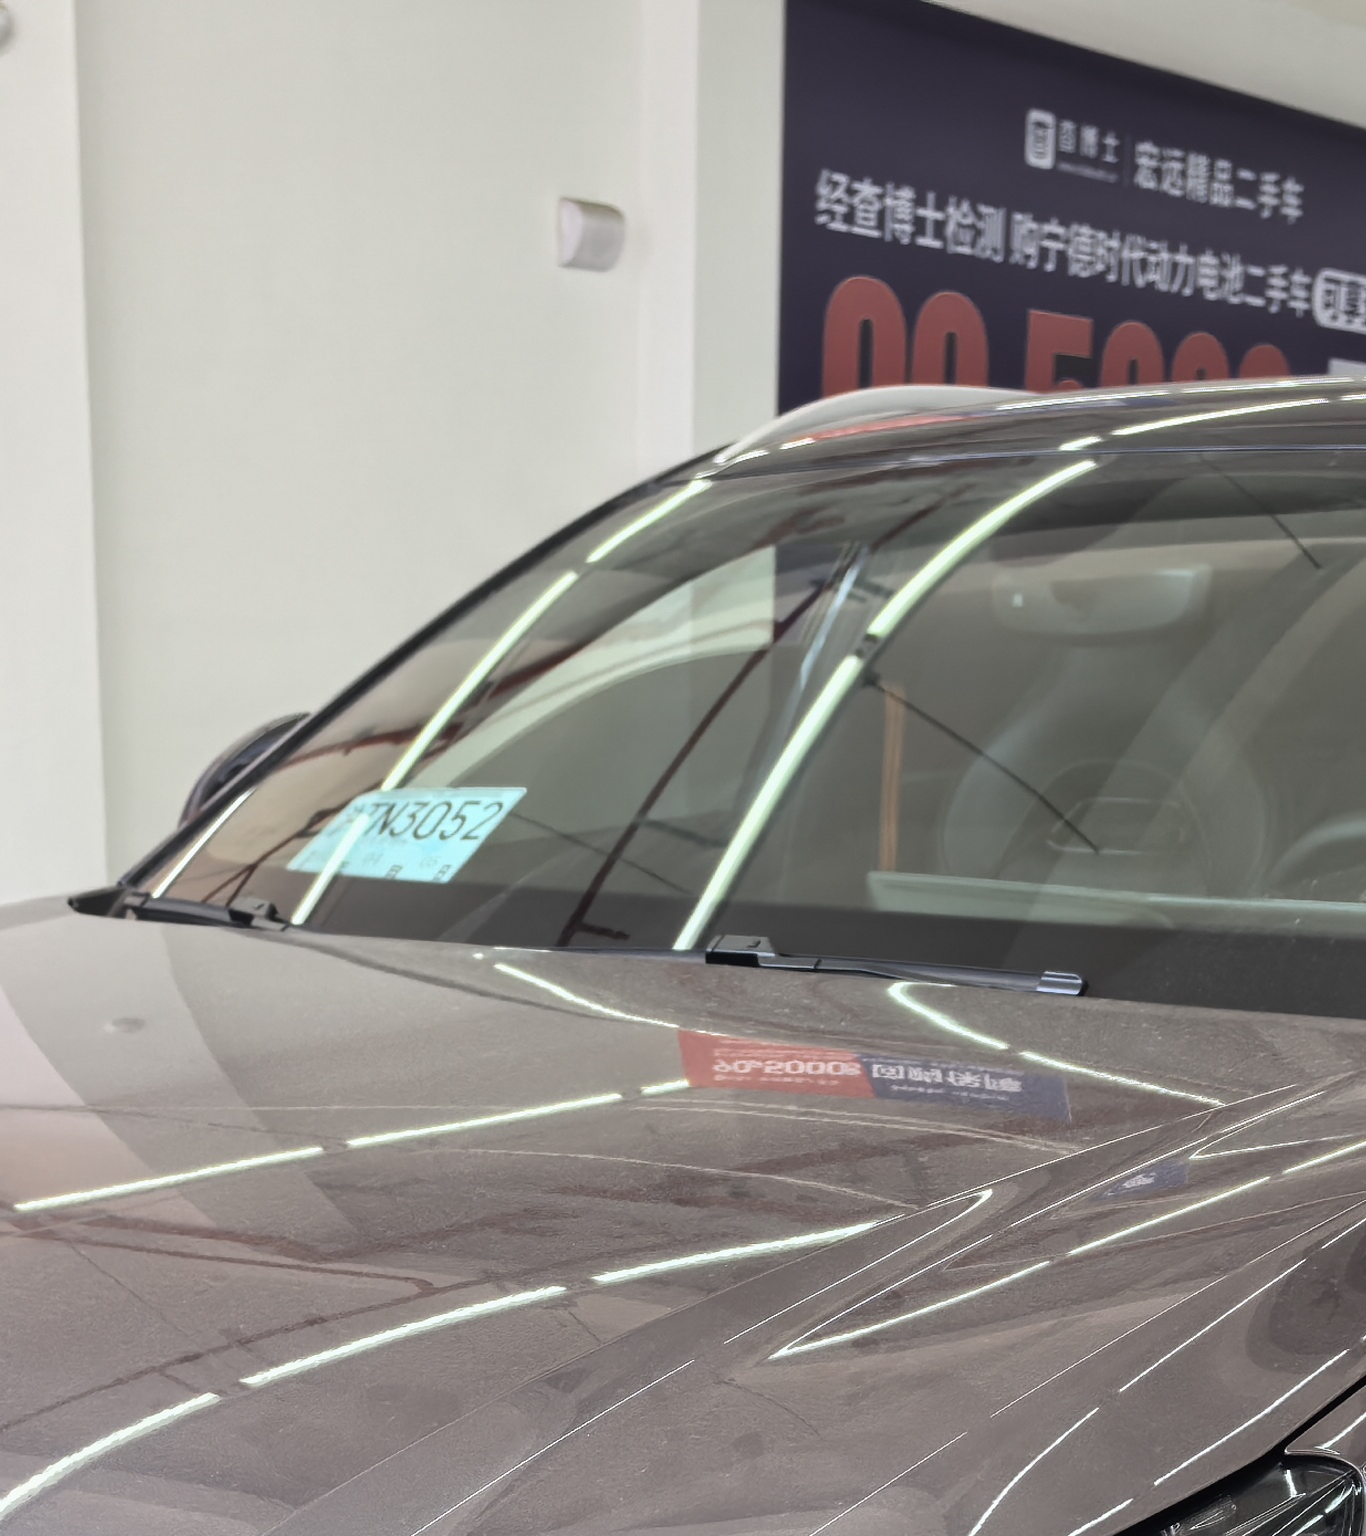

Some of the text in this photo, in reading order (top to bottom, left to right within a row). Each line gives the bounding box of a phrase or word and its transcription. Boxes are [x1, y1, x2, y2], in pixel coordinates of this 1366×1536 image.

[1134, 139, 1305, 224] 宏远精品二手车
[333, 800, 505, 841] TN3052
